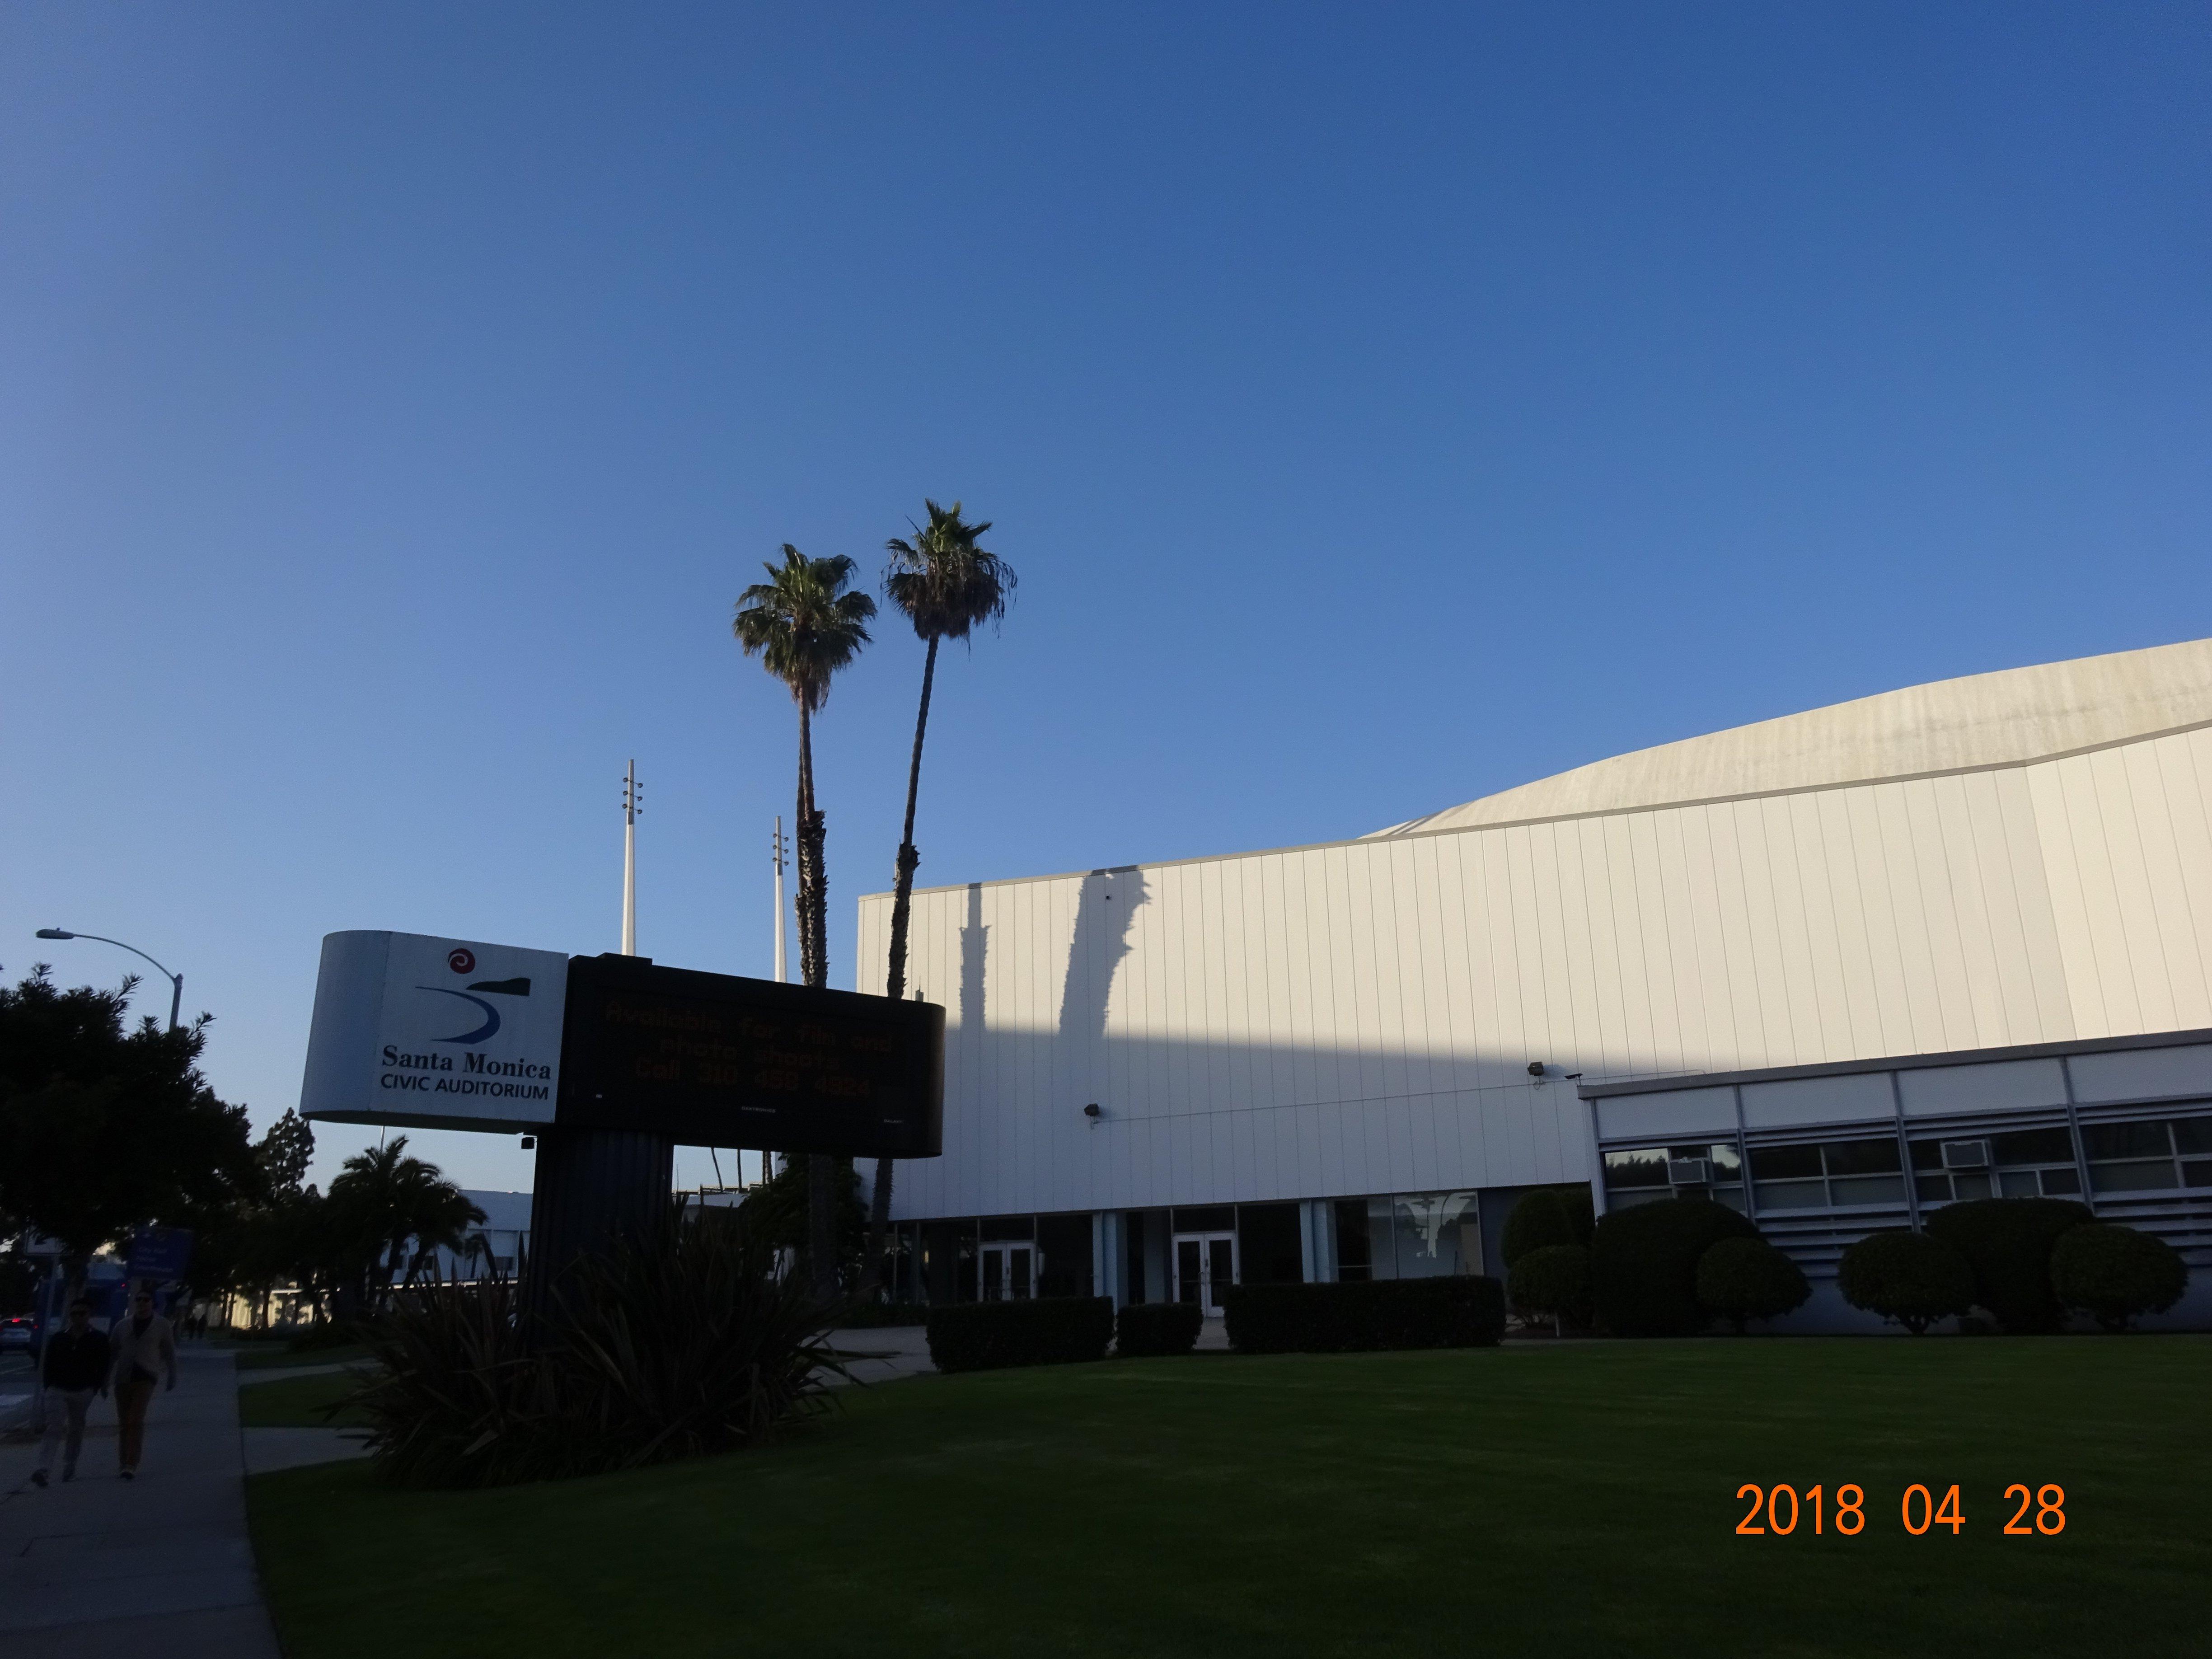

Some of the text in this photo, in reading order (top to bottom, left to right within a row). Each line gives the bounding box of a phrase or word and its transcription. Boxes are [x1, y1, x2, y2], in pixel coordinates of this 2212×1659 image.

[605, 1000, 893, 1052] Available for film and
[382, 1045, 551, 1080] Santa Monica
[660, 1034, 840, 1070] photo shoots
[380, 1073, 548, 1100] CIVIC AUDITORIUM
[635, 1056, 681, 1081] Call
[696, 1062, 739, 1086] 310
[754, 1069, 799, 1091] 458
